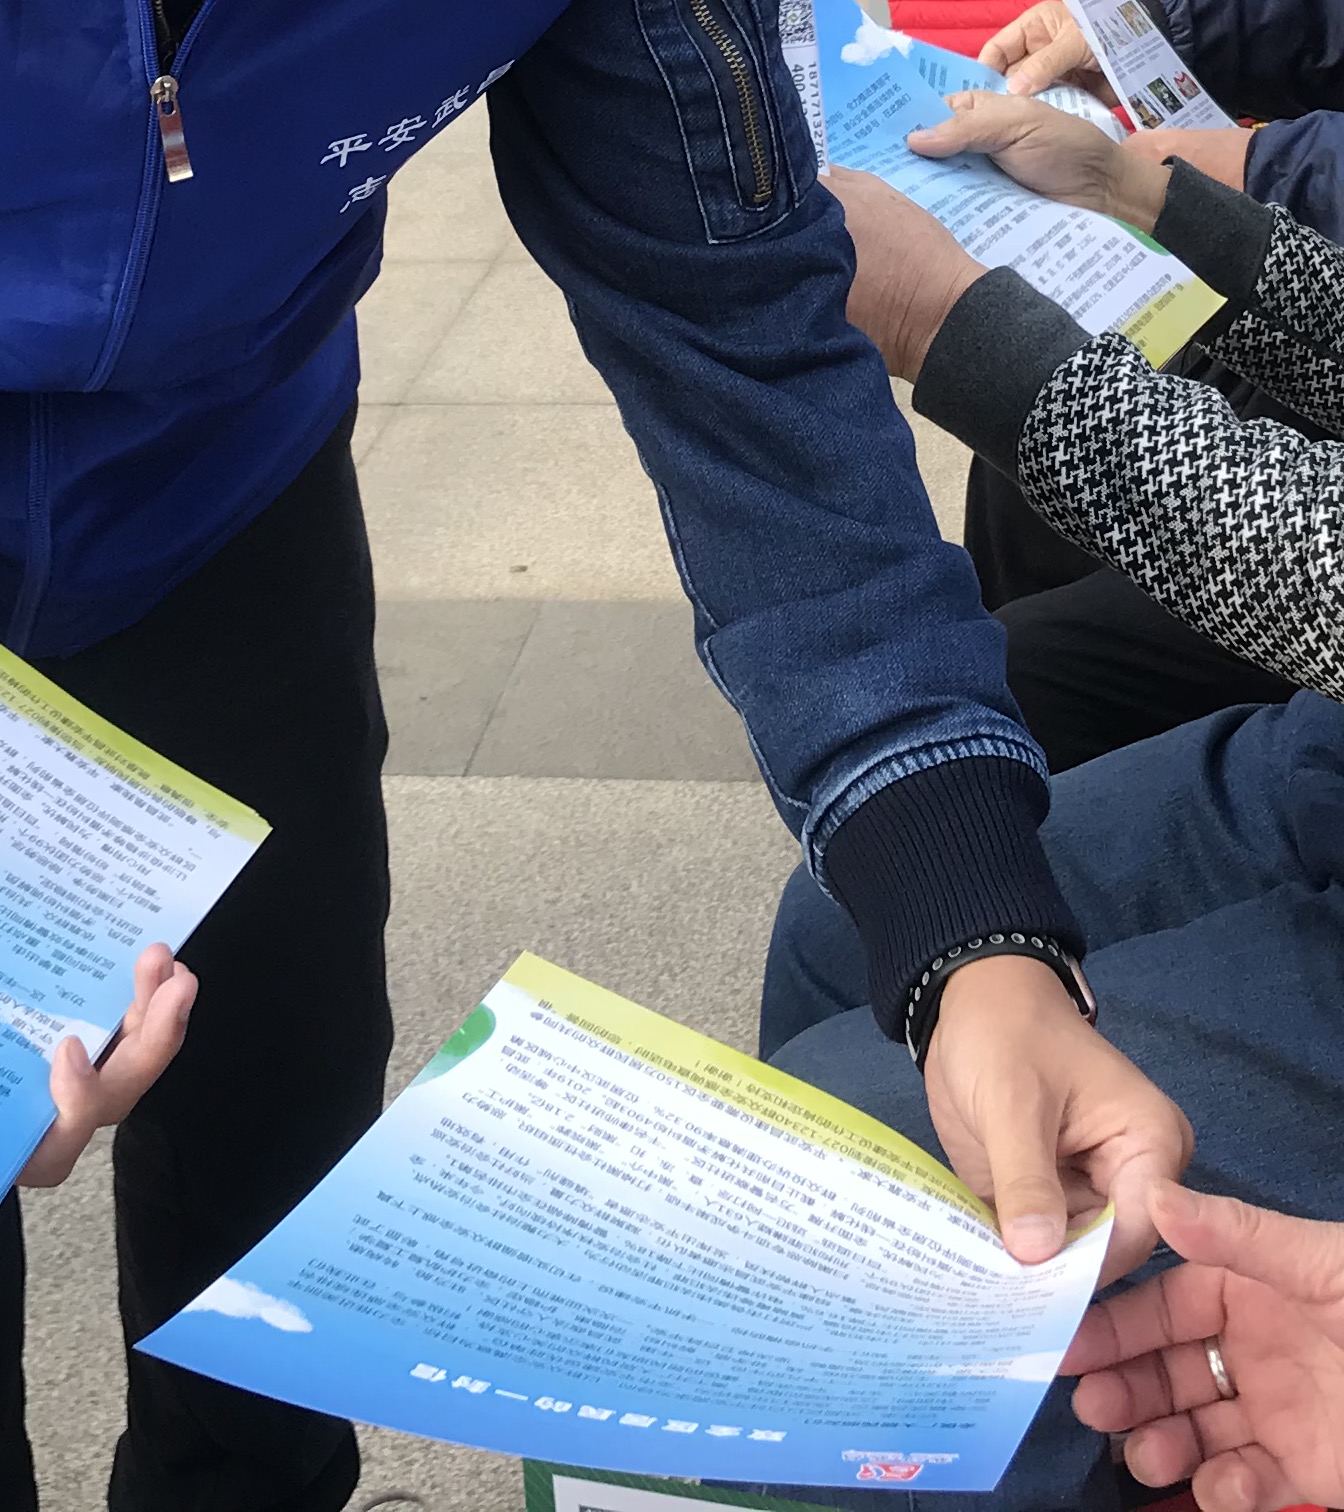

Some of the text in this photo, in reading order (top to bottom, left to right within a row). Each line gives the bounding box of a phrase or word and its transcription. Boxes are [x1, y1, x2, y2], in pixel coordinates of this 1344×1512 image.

[405, 1362, 787, 1443] 致全区居民的一封信
